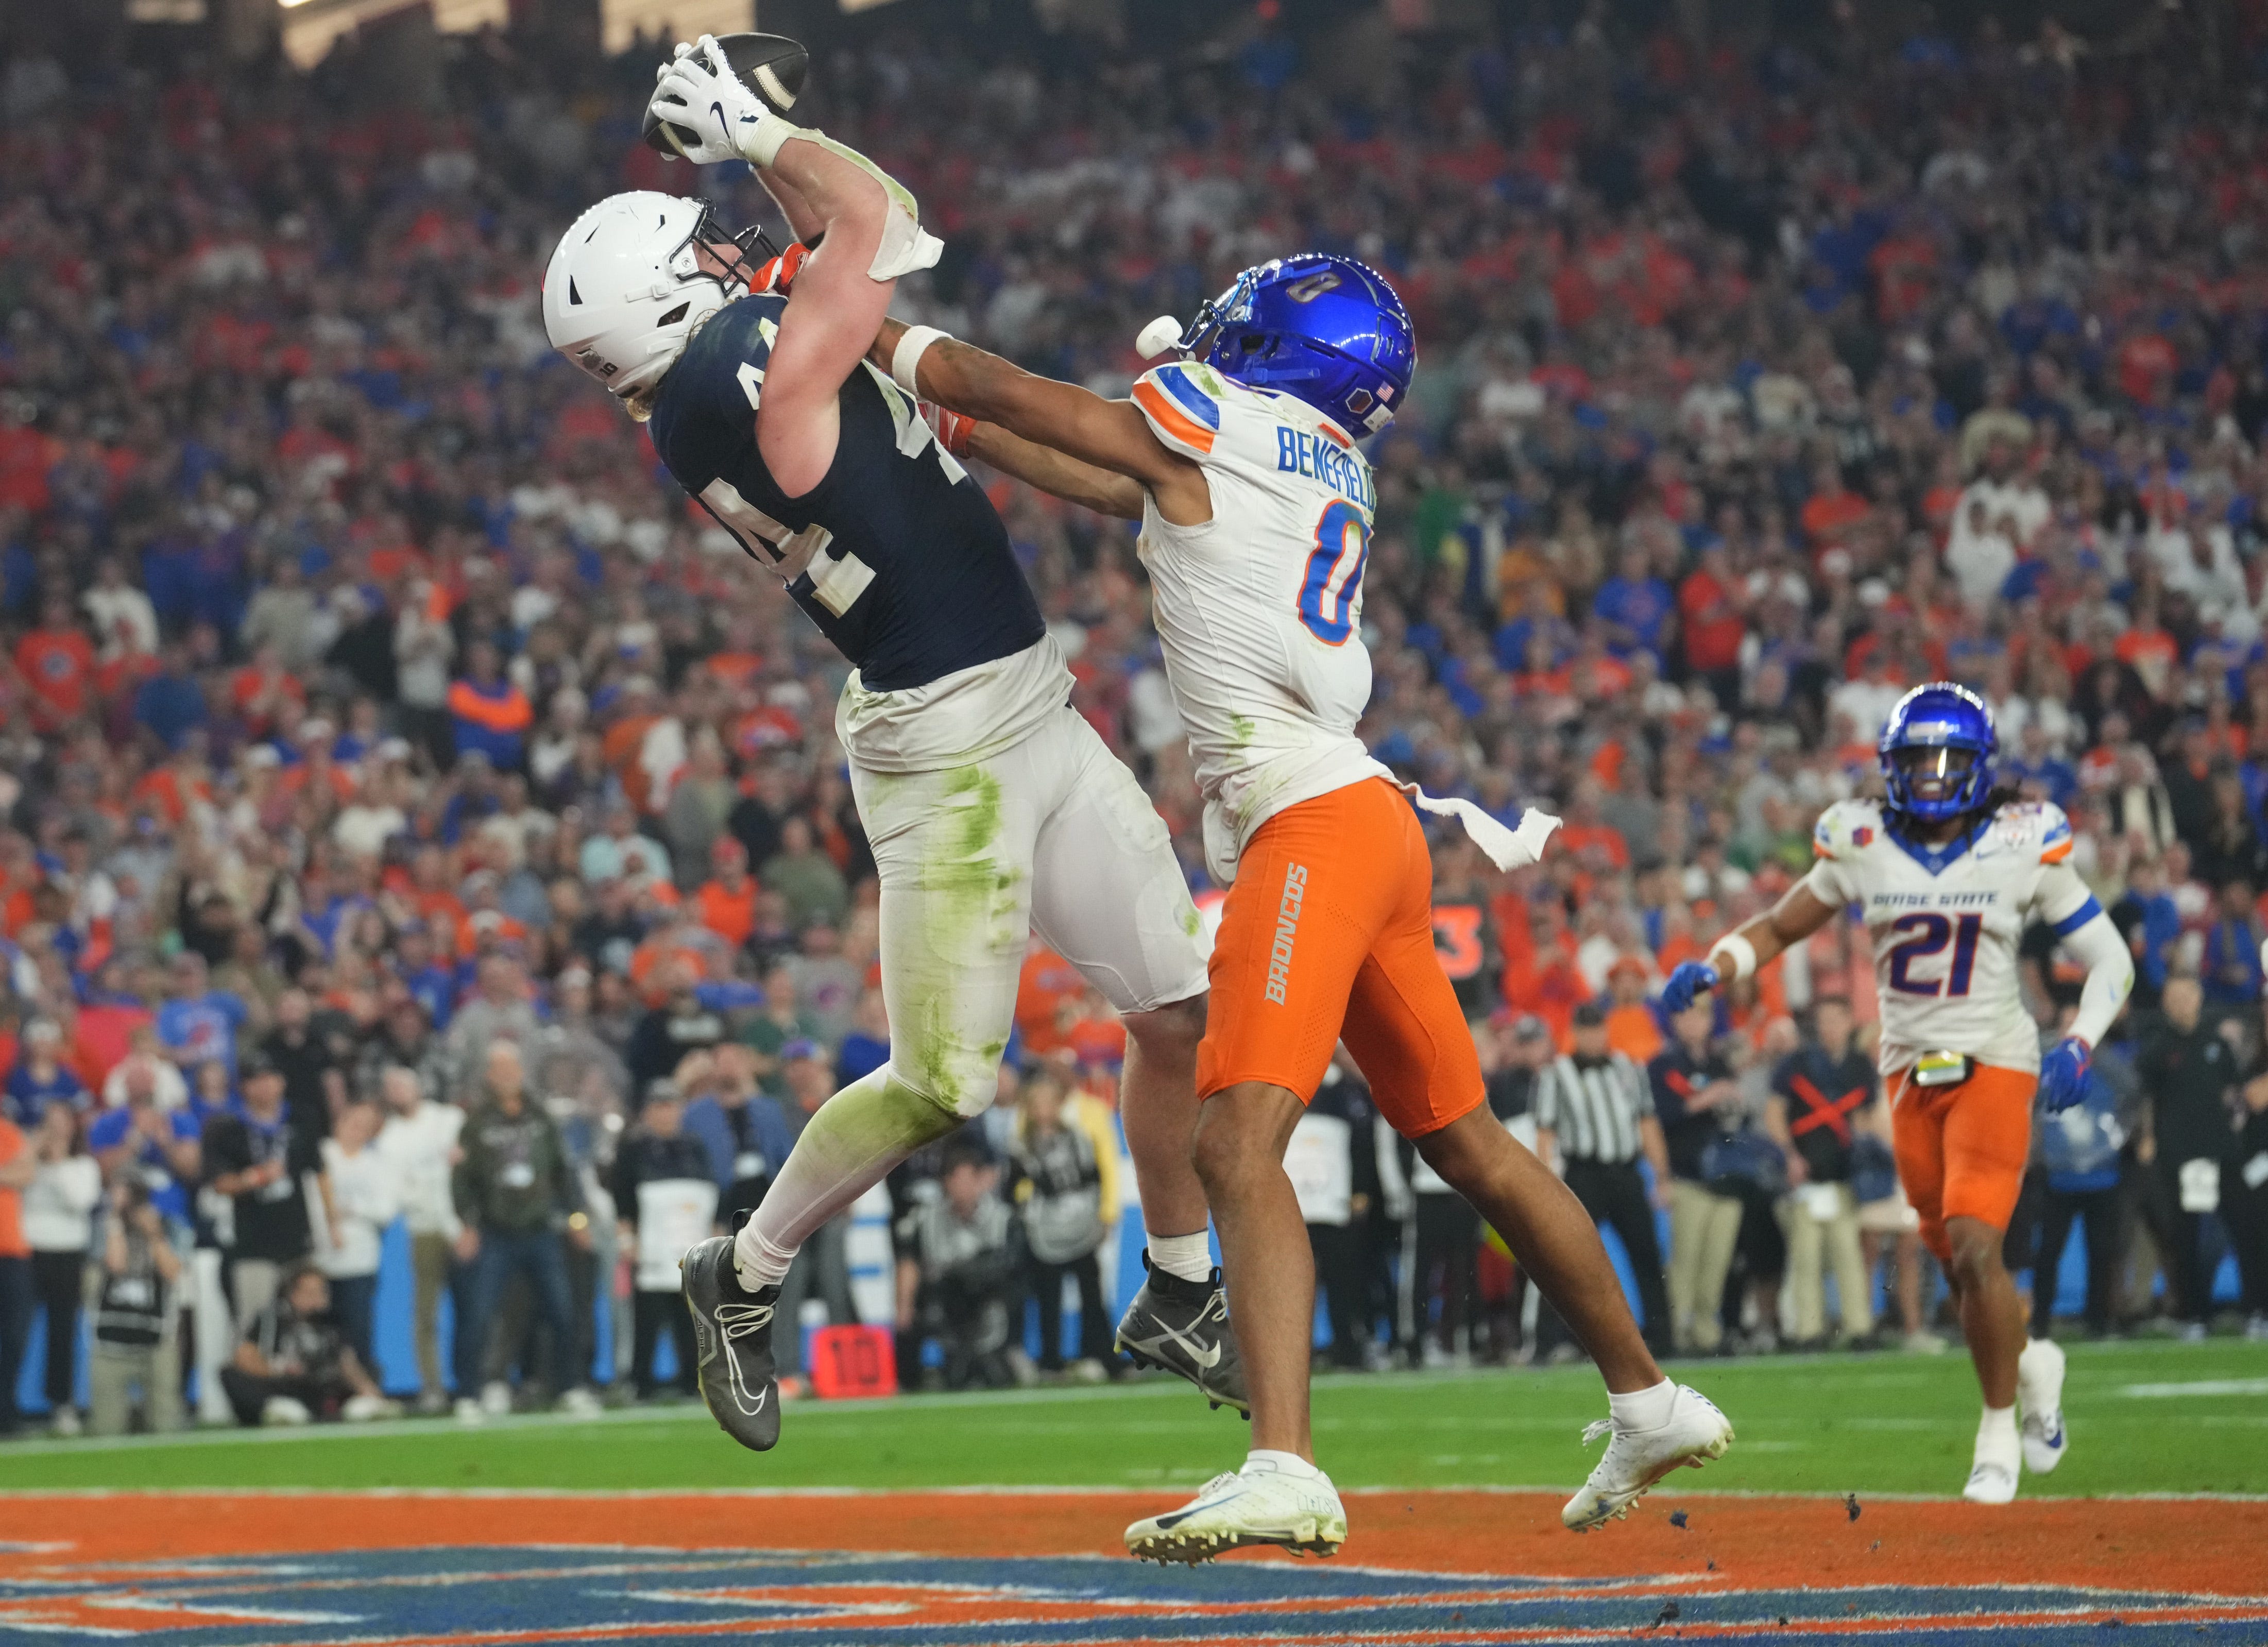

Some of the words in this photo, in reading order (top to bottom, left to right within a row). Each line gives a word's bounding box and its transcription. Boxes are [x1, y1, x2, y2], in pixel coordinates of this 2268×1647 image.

[1277, 426, 1375, 512] BENEFIELD
[1296, 498, 1374, 647] 0
[1264, 862, 1307, 1006] BRONCOS
[1938, 890, 2000, 906] STATE
[1889, 911, 1983, 997] 21
[831, 1337, 880, 1386] 10
